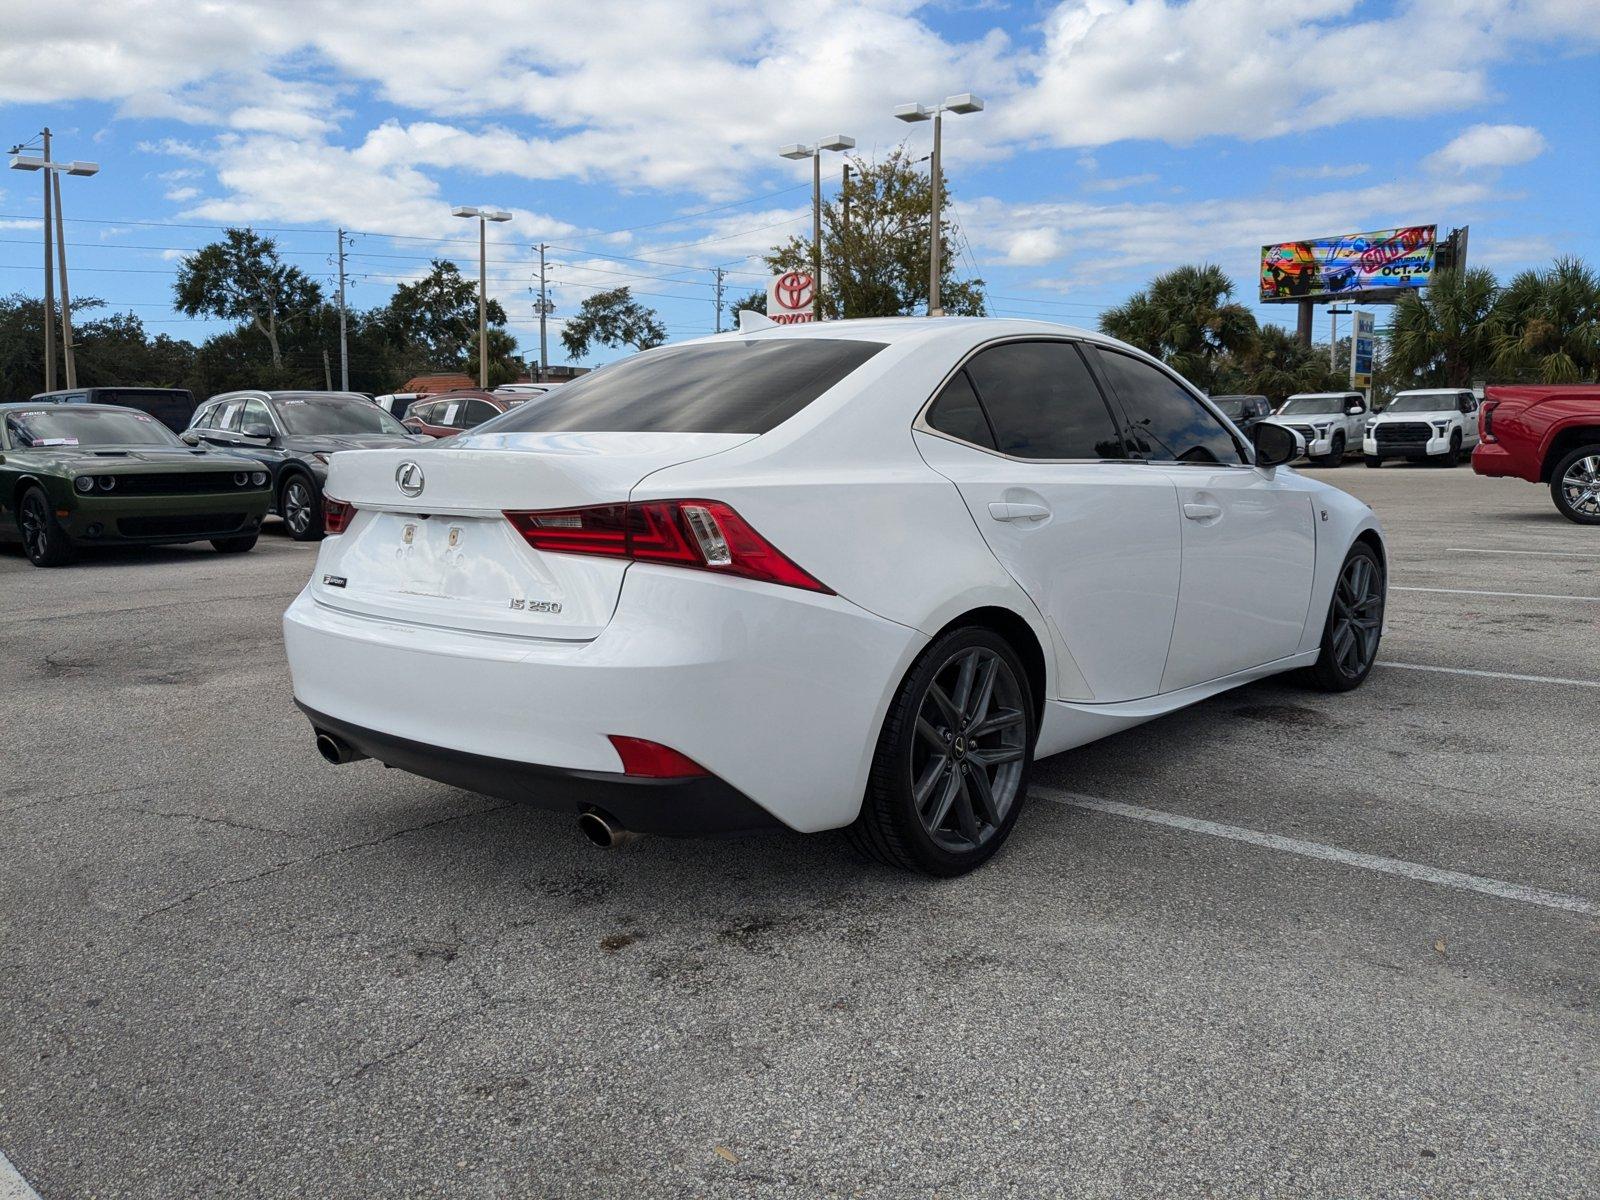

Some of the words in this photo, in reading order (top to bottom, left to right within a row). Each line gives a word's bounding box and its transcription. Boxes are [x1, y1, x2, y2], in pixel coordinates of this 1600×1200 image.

[1365, 243, 1399, 268] SOLD
[1389, 256, 1426, 265] ATURDAY
[1382, 264, 1412, 276] OCT.
[1414, 262, 1431, 273] 26
[768, 313, 814, 325] TOYOT
[508, 598, 526, 611] IS
[528, 600, 563, 613] 250
